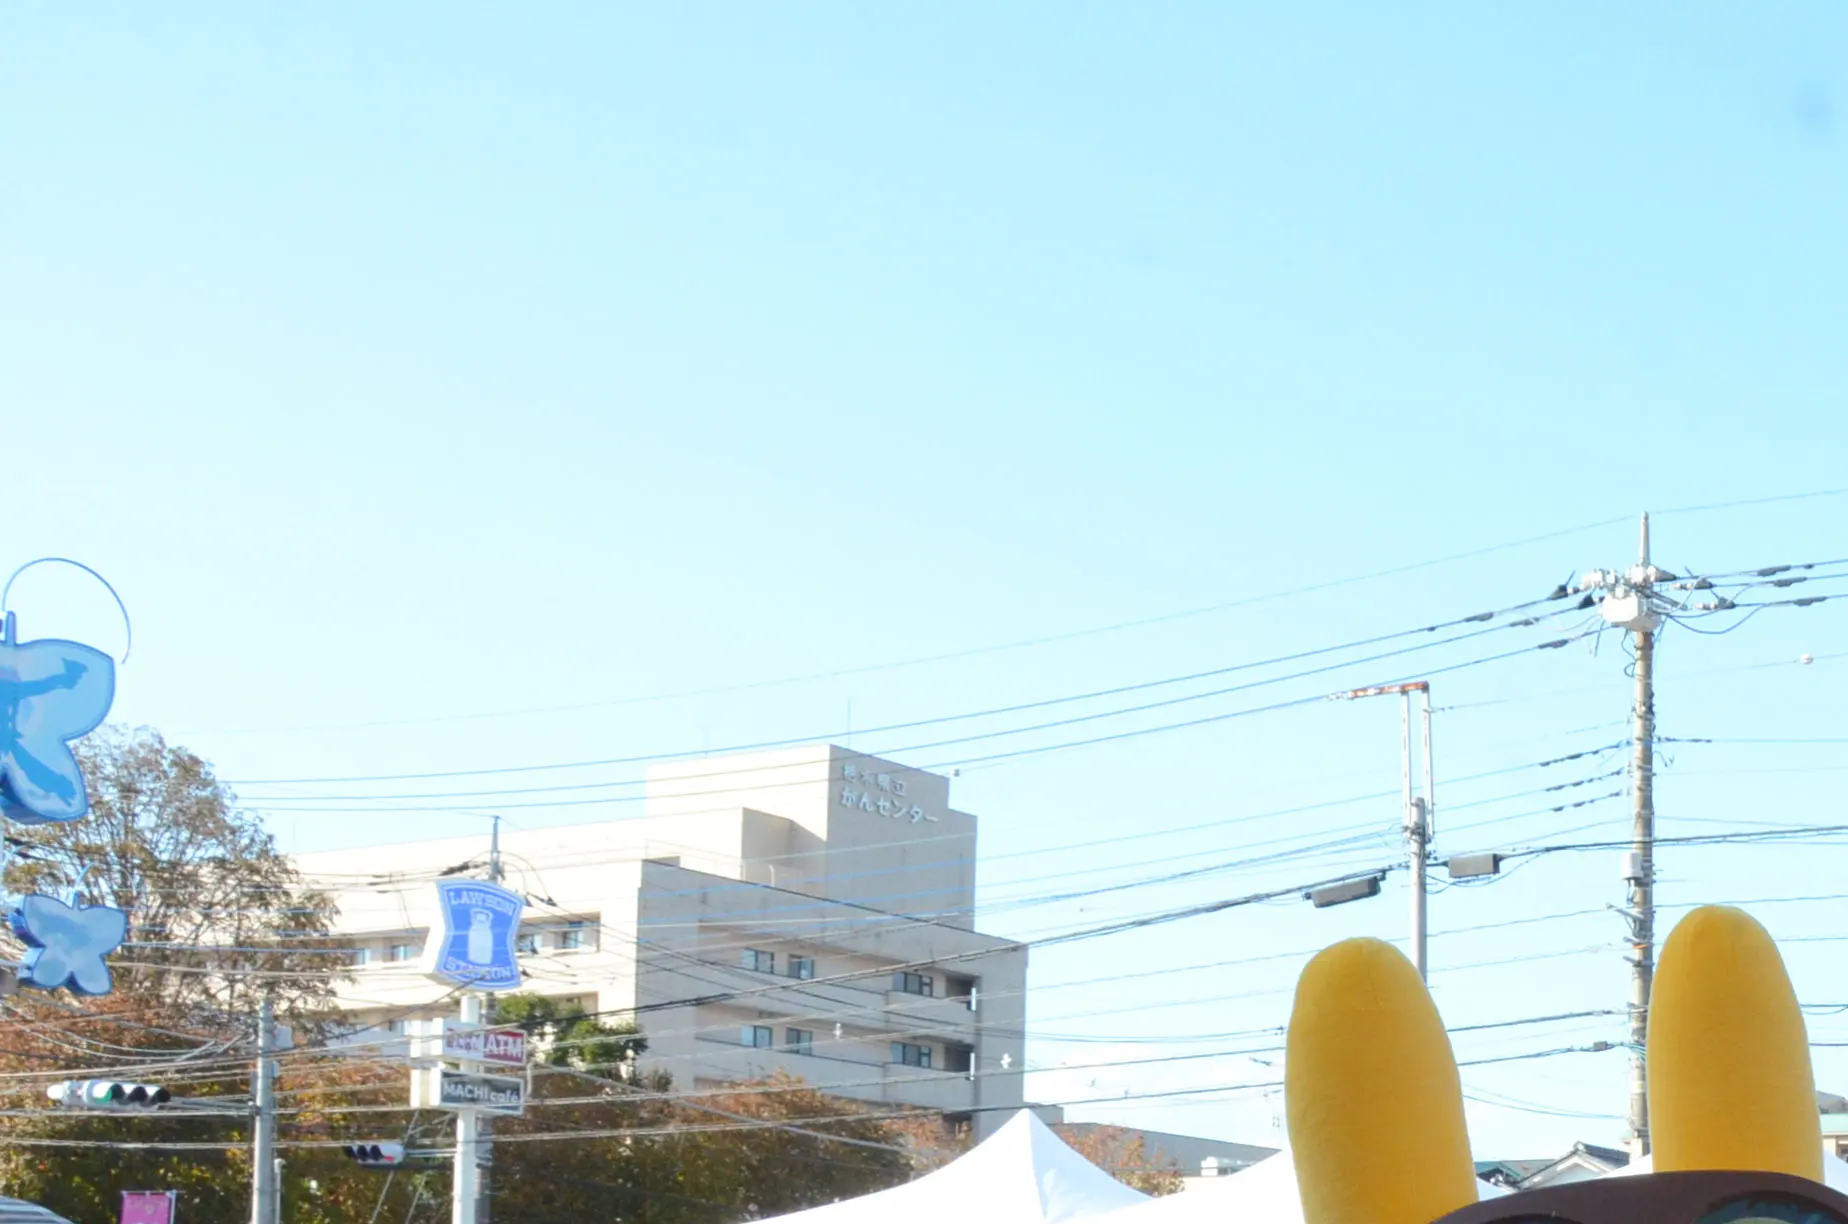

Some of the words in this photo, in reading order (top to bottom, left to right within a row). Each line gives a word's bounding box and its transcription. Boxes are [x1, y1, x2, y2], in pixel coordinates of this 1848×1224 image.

[842, 786, 939, 823] がんセンター
[450, 891, 517, 916] LAWSON
[485, 1033, 522, 1058] ATM
[443, 1082, 488, 1099] MACHI
